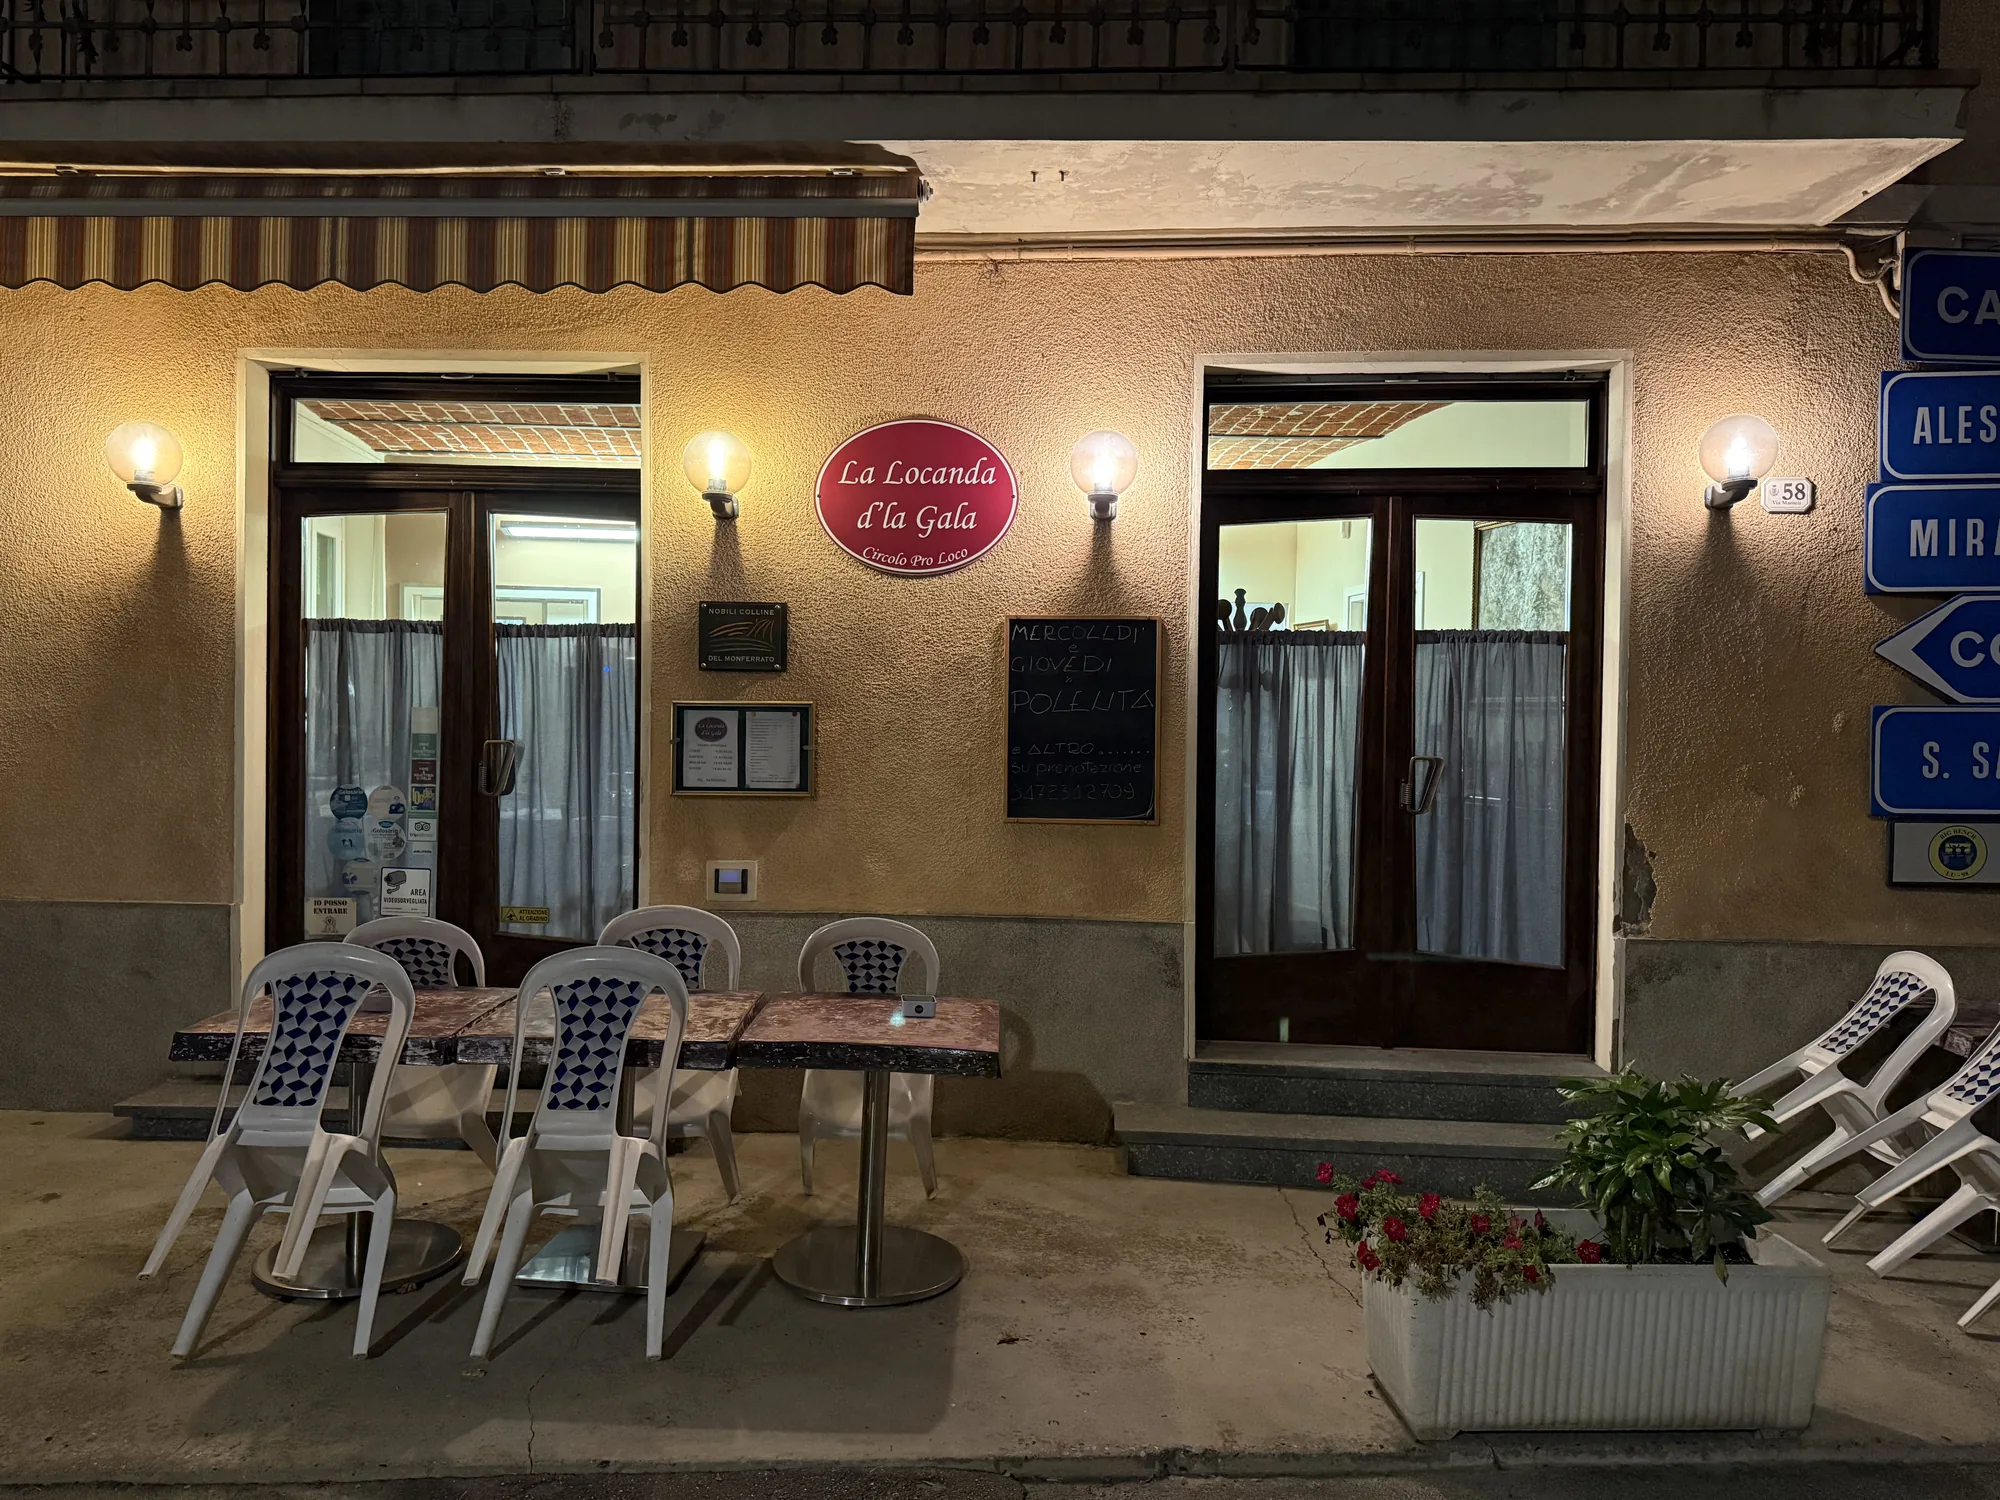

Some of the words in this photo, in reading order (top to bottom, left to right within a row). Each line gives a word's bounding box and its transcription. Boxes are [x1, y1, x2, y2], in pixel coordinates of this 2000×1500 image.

[1937, 286, 2000, 325] CA
[1913, 404, 1998, 445] ALES
[838, 460, 876, 485] La
[882, 457, 997, 485] Locanda
[1782, 482, 1806, 501] 58
[857, 501, 907, 530] d'la
[916, 501, 978, 539] Gala
[862, 546, 908, 566] Circolo
[910, 554, 934, 567] Pro
[937, 548, 969, 565] Loco
[739, 608, 775, 616] COLLINE
[708, 654, 723, 662] DEL
[724, 655, 775, 663] MONFERRATO
[1950, 630, 2000, 668] C
[1010, 655, 1113, 673] GIOVEDI
[1010, 688, 1155, 715] POLENTA
[1922, 740, 1950, 779] S.
[1972, 740, 2000, 780] S
[1939, 830, 1952, 840] BIG
[1953, 829, 1976, 840] BENCH
[383, 897, 428, 905] VIDEOSORVEGLIATA
[410, 888, 427, 897] AREA
